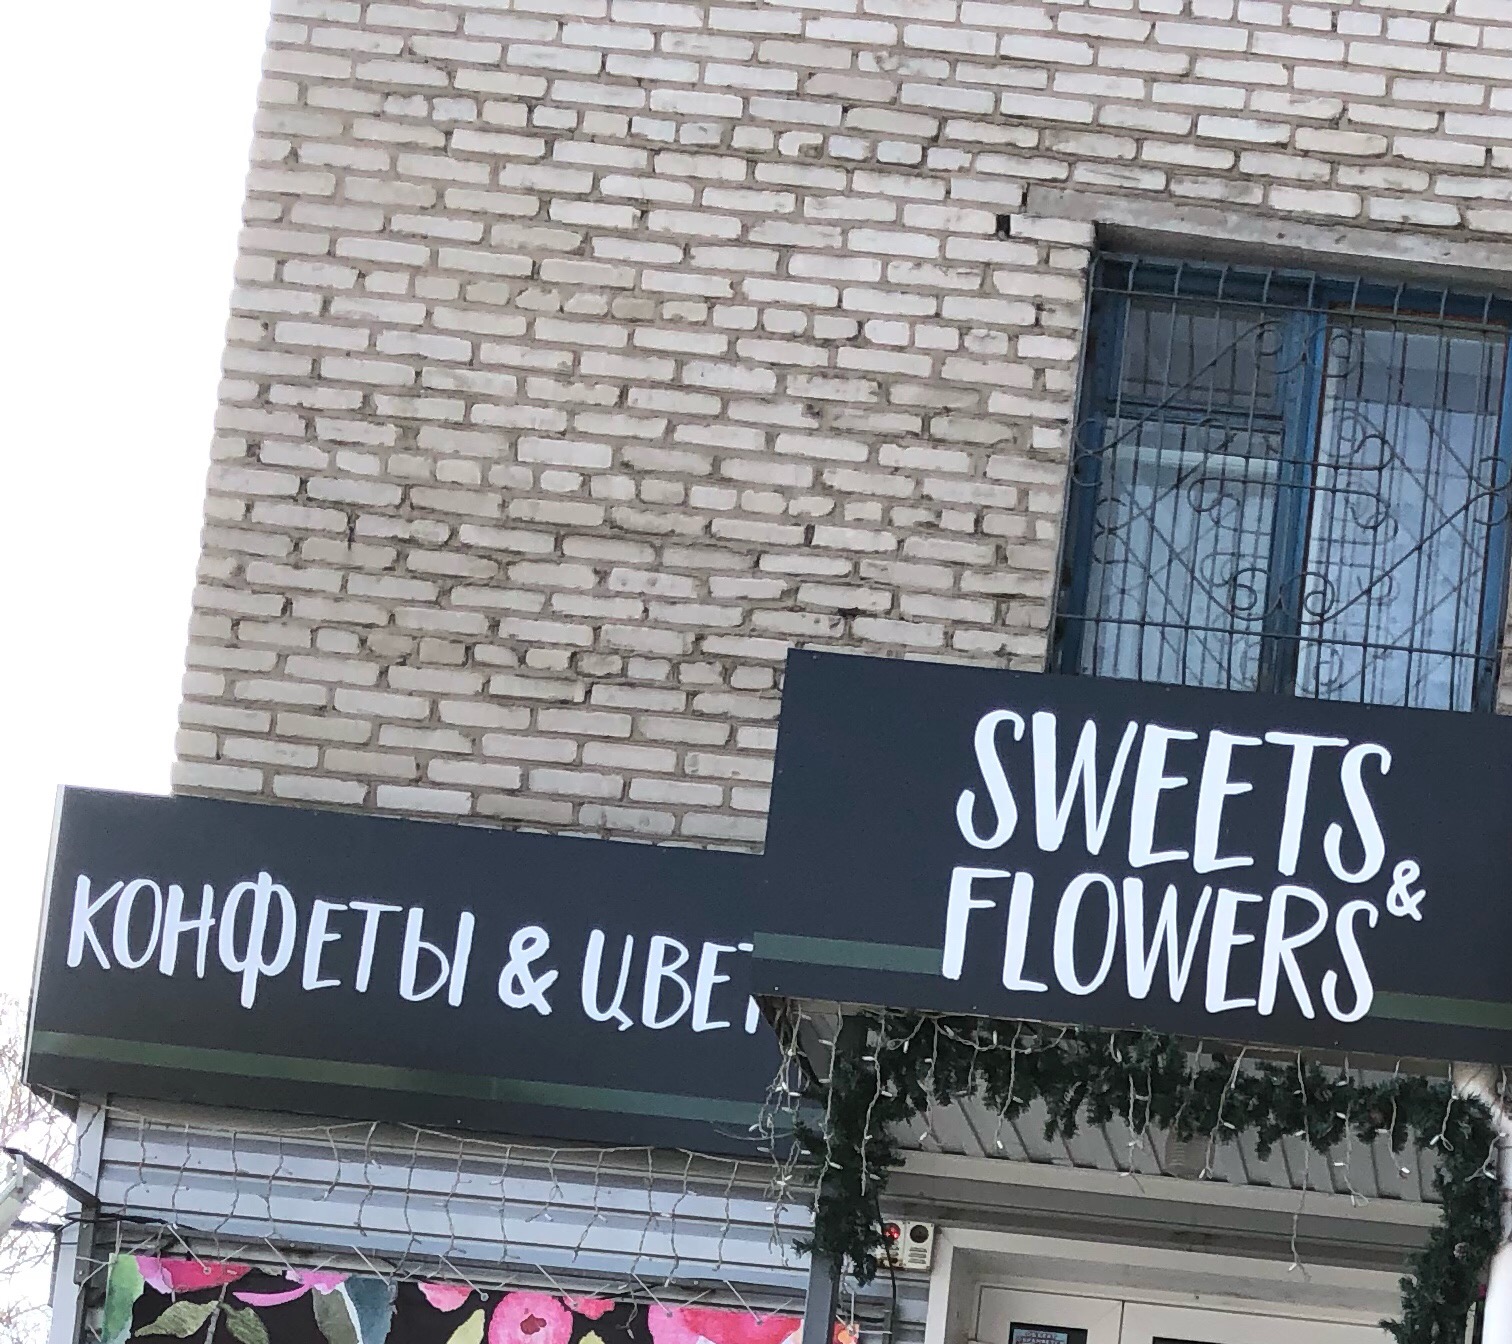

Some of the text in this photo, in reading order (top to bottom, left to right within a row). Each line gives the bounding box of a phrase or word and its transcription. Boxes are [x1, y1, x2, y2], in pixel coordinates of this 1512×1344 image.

[955, 709, 1426, 921] SWEETS &
[66, 871, 475, 1008] КОНФЕТЫ
[497, 926, 559, 1015] &
[941, 866, 1378, 1022] FLOWERS
